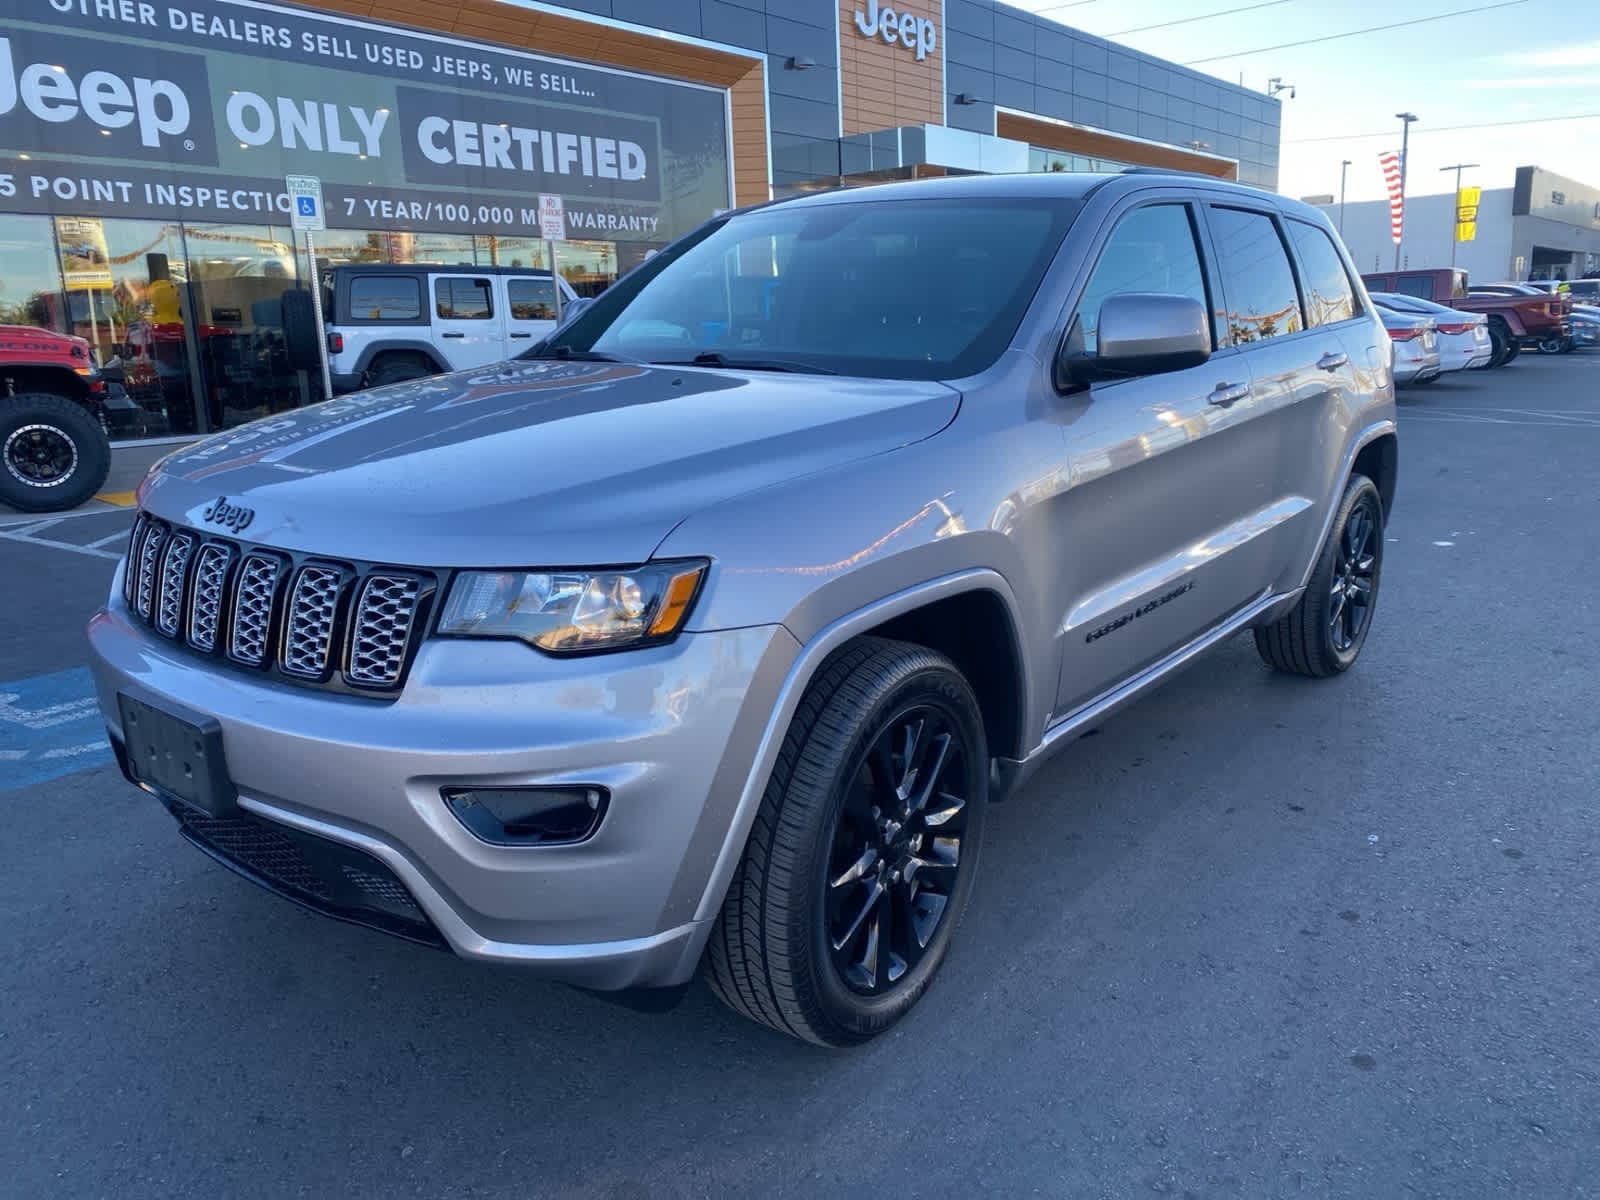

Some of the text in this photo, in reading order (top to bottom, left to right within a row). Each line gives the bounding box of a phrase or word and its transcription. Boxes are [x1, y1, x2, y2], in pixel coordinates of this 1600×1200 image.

[168, 7, 292, 49] DEALERS
[302, 31, 358, 60] SELL
[364, 42, 424, 70] USED
[431, 55, 499, 85] JEEPS,
[504, 66, 534, 88] WE
[539, 73, 596, 97] SELL...
[855, 0, 937, 61] Jeep
[226, 91, 390, 158] ONLY
[417, 115, 647, 182] CERTIFIED
[30, 175, 133, 203] POINT
[144, 183, 292, 213] INSPECTIO
[343, 197, 356, 216] 7
[364, 199, 514, 225] YEAR/100,000
[567, 211, 660, 233] WARRANTY
[203, 496, 255, 534] Jeep
